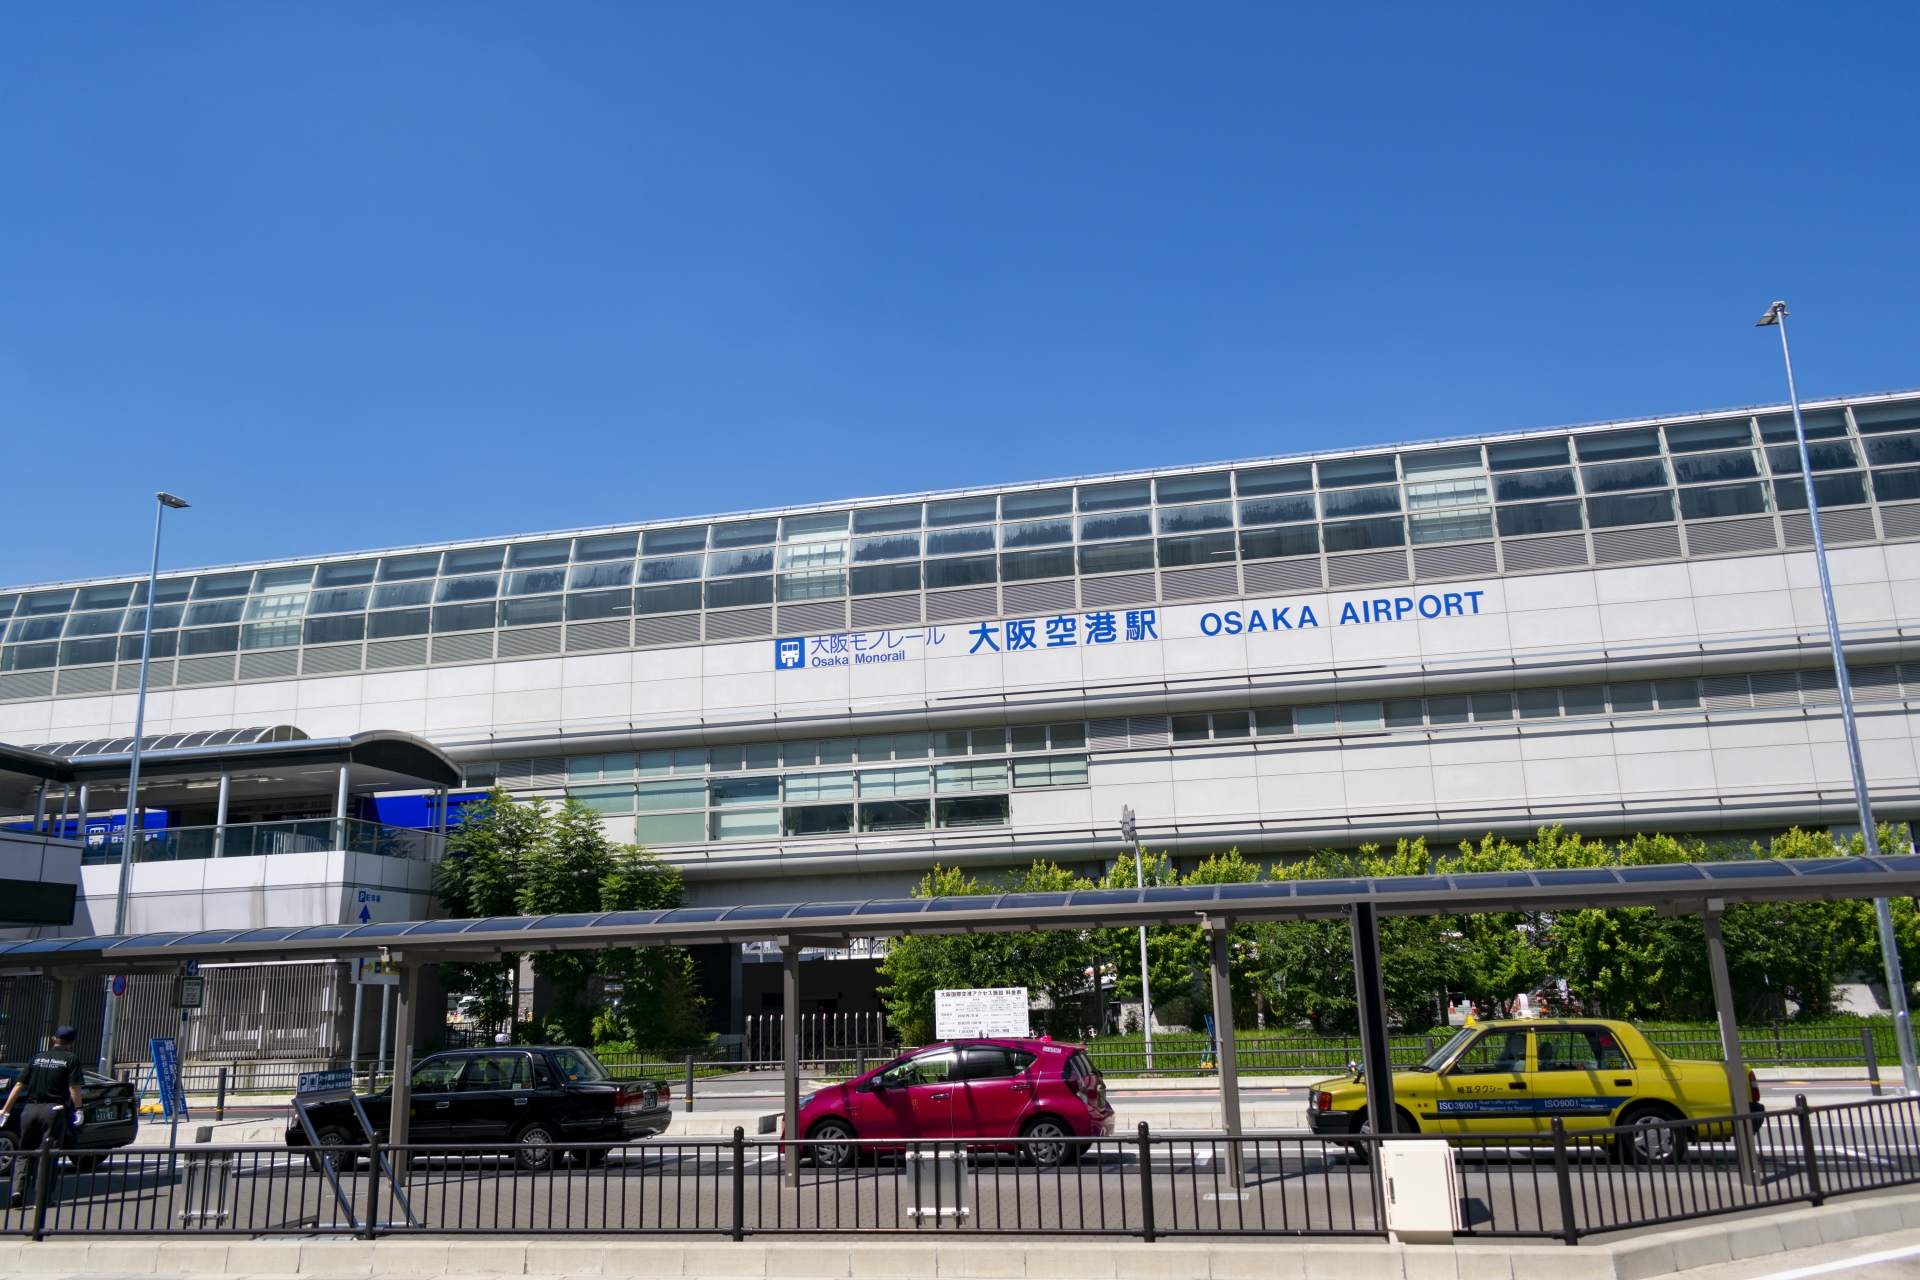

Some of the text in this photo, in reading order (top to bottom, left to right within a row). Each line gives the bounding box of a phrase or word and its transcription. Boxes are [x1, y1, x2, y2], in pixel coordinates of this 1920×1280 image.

[1200, 590, 1484, 636] OSAKA AIRPORT
[968, 609, 1158, 654] 大阪空港駅
[811, 627, 945, 655] 大阪モノレール
[811, 650, 905, 667] Osaka Monorail
[188, 960, 197, 976] 4
[300, 1076, 307, 1091] P
[1456, 1085, 1503, 1094] 相互タクシー
